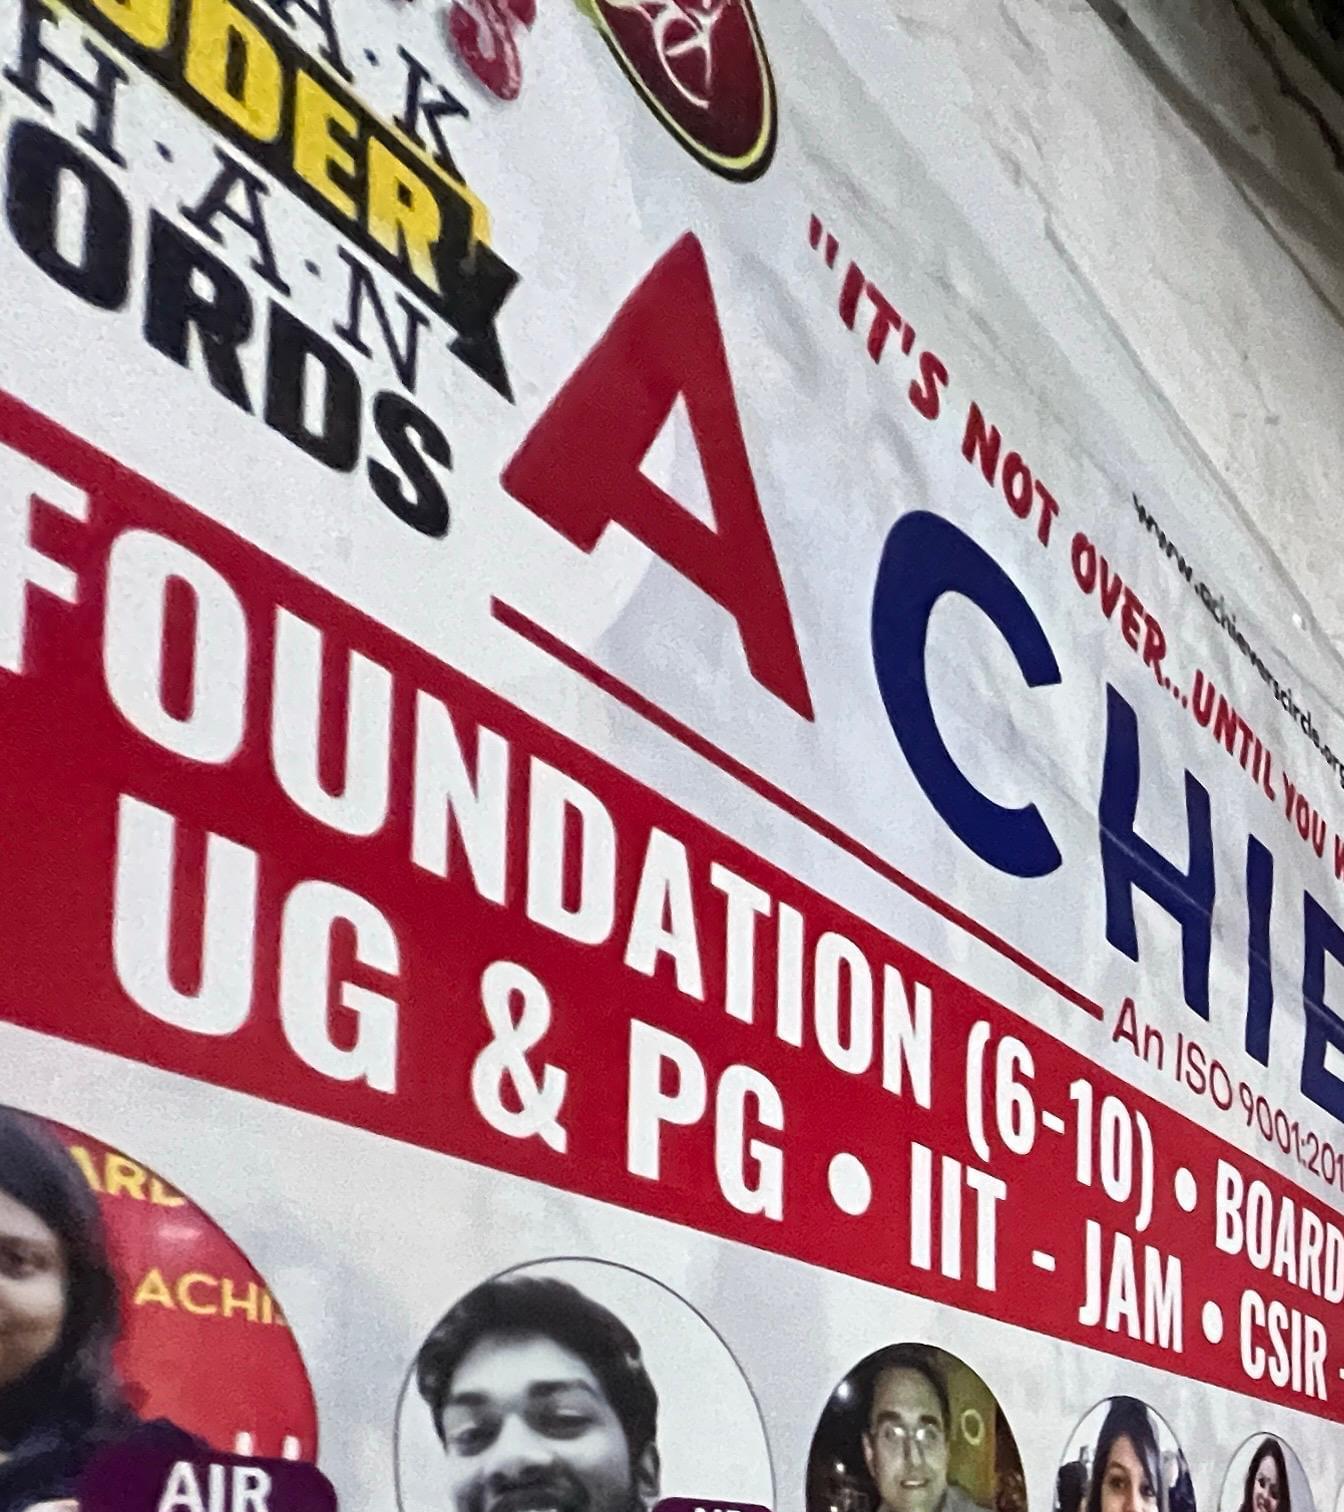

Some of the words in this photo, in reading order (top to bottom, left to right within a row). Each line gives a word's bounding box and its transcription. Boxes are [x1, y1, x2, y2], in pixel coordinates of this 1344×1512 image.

[5, 119, 453, 540] ORDS
[90, 0, 442, 298] DER
[0, 438, 933, 1108] FOUNDATION
[965, 1020, 1154, 1232] (6-10)
[961, 401, 1060, 548] NOT
[1282, 771, 1325, 859] YOU
[112, 792, 401, 1096] UG
[471, 959, 568, 1155] &
[627, 1016, 786, 1223] PG
[909, 1140, 1008, 1293] IIT
[1077, 1220, 1185, 1354] JAM
[1240, 1288, 1329, 1401] CSIR
[1112, 995, 1165, 1071] An
[1175, 1032, 1233, 1112] ISO
[133, 1266, 286, 1326] ACHI
